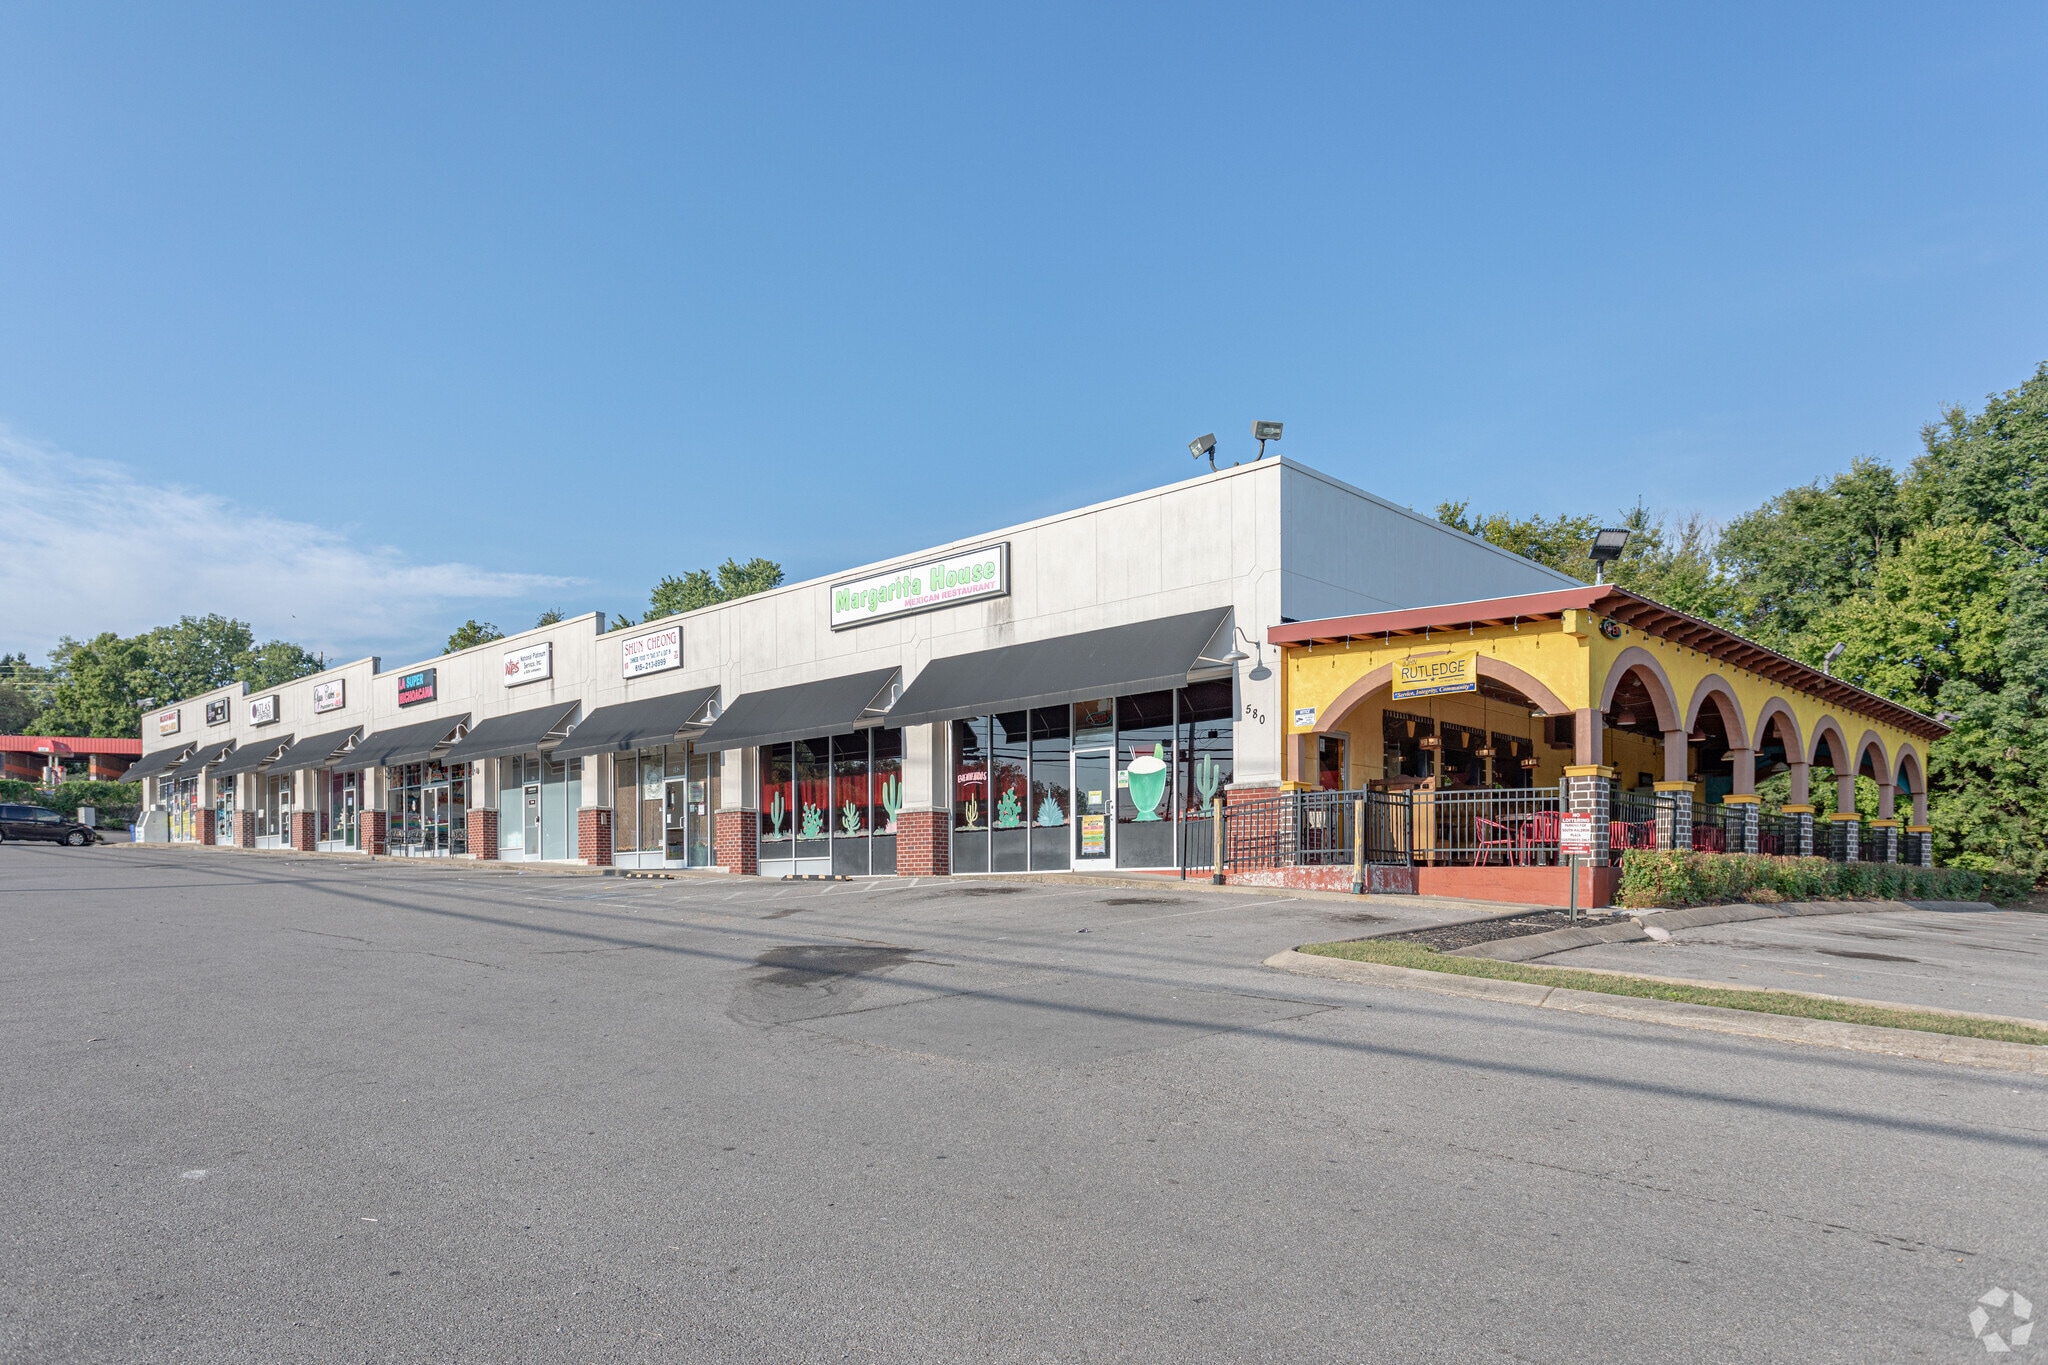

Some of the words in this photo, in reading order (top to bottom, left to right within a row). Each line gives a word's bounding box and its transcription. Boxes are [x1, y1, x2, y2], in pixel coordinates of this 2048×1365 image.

[835, 575, 921, 613] Margarita
[930, 561, 996, 591] House
[904, 593, 940, 607] MEXICAN
[941, 581, 996, 599] RESTAURANT
[625, 640, 643, 656] SHUN
[646, 632, 677, 650] CHEONG
[1401, 660, 1466, 679] RUTLEDGE
[398, 678, 406, 691] LA
[406, 673, 424, 689] SUPER
[1246, 704, 1266, 725] 580
